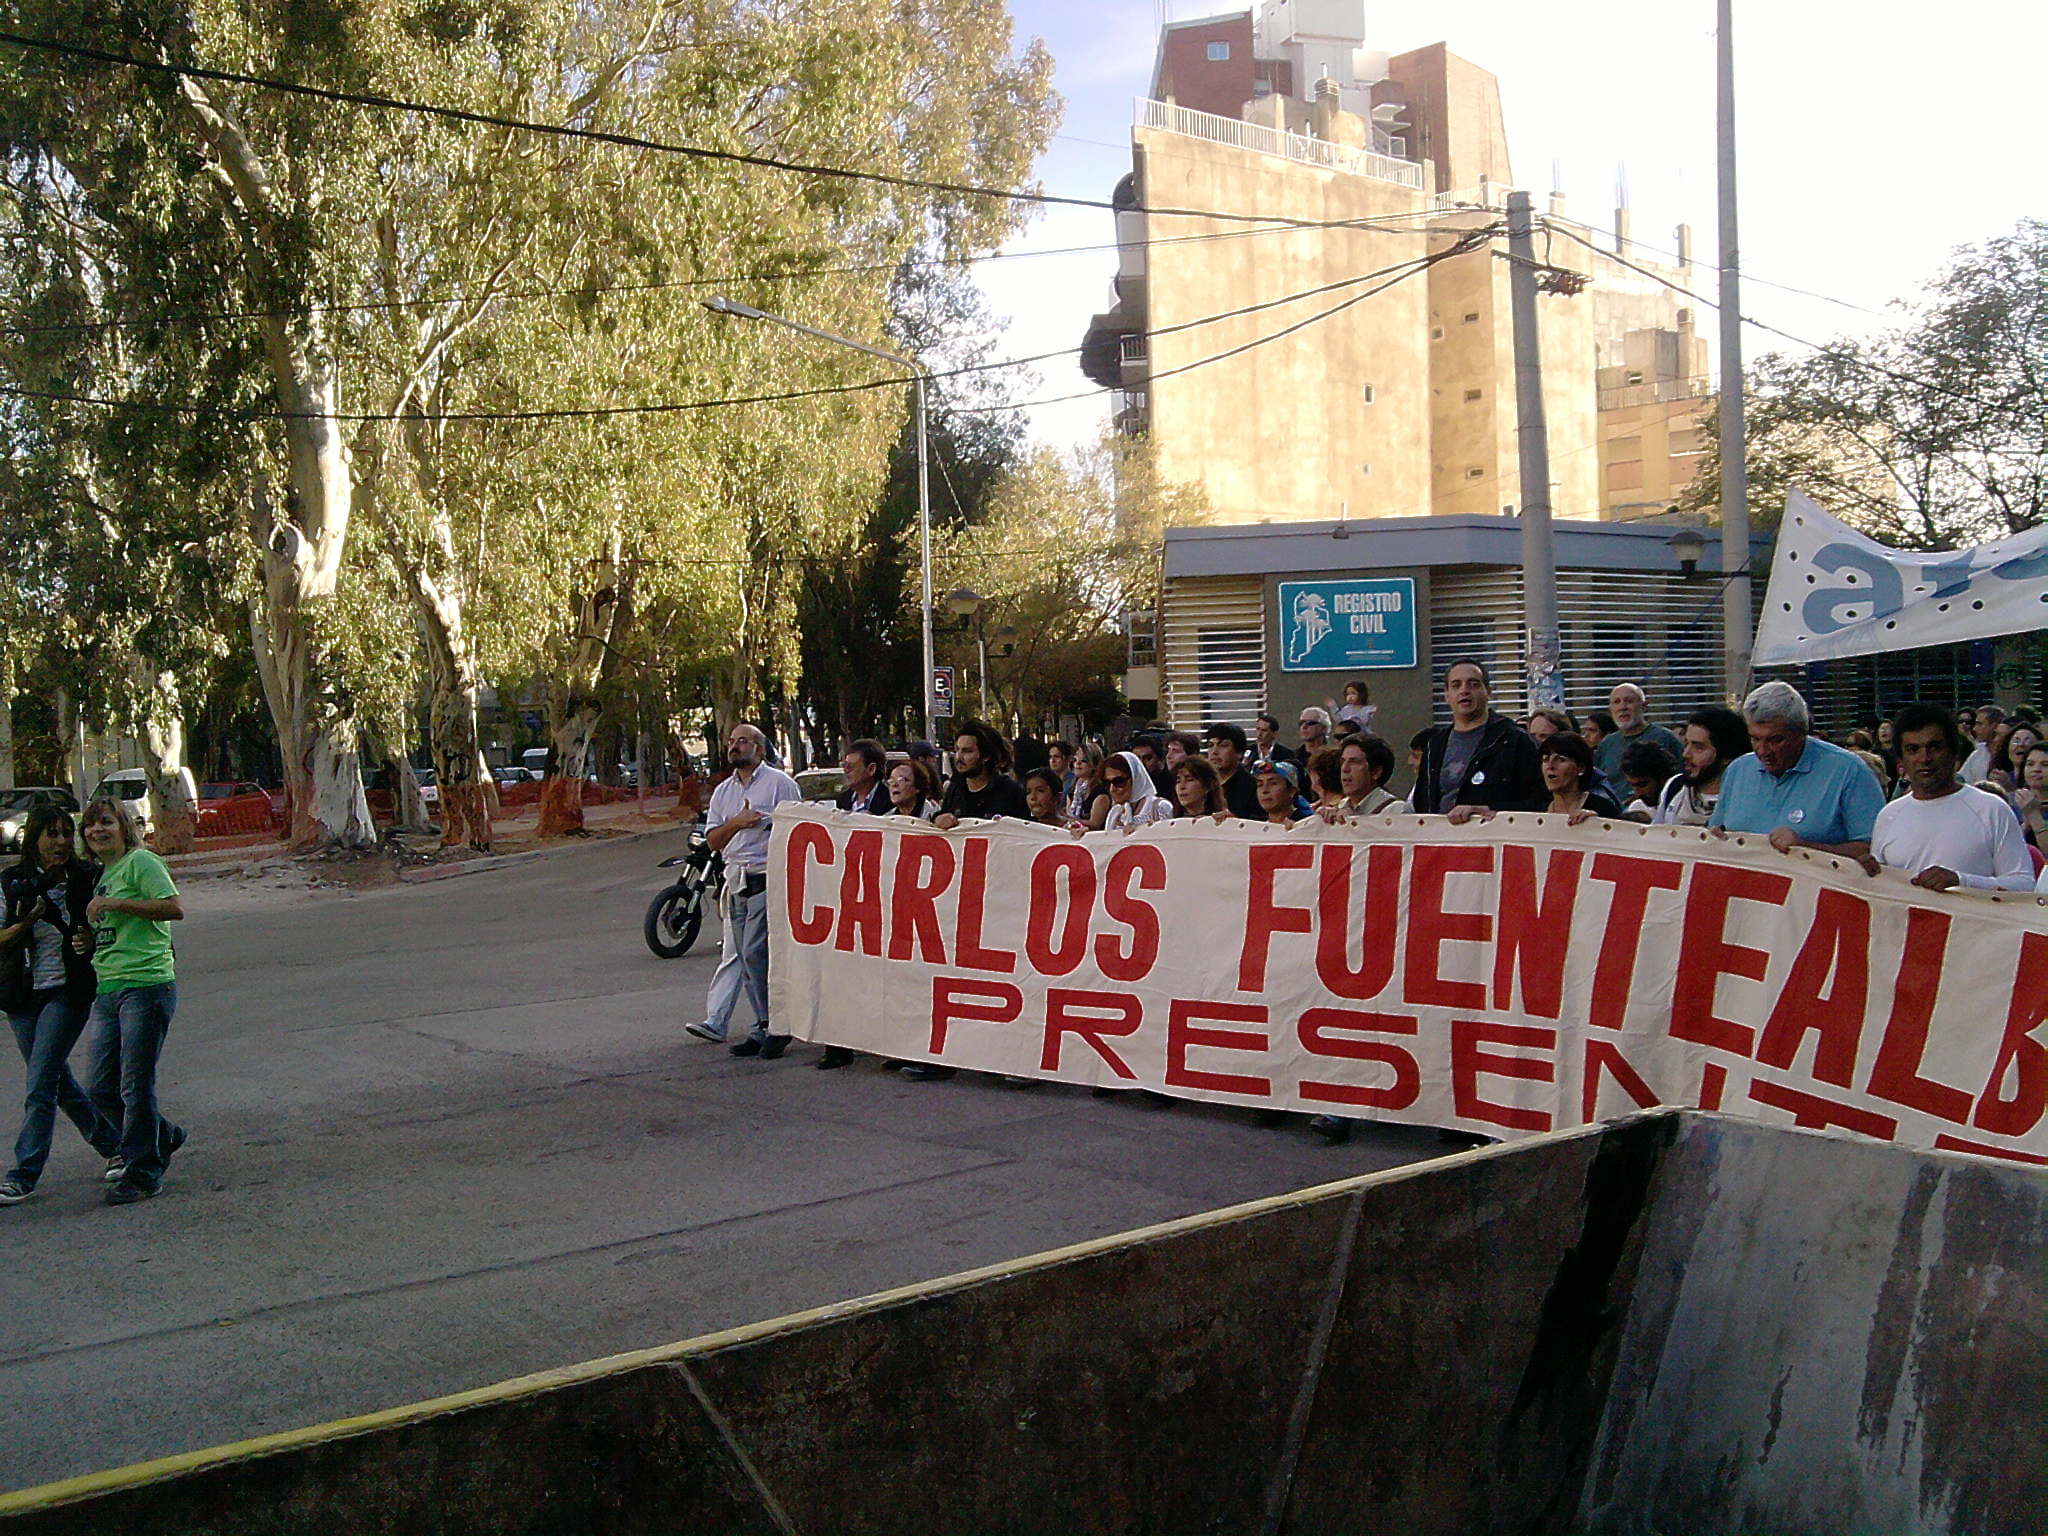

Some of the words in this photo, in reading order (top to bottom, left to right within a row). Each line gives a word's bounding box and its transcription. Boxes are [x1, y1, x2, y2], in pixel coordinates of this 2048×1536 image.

[1334, 591, 1401, 614] REGISTRO
[1350, 614, 1388, 634] CIVIL
[786, 821, 1167, 982] CARLOS
